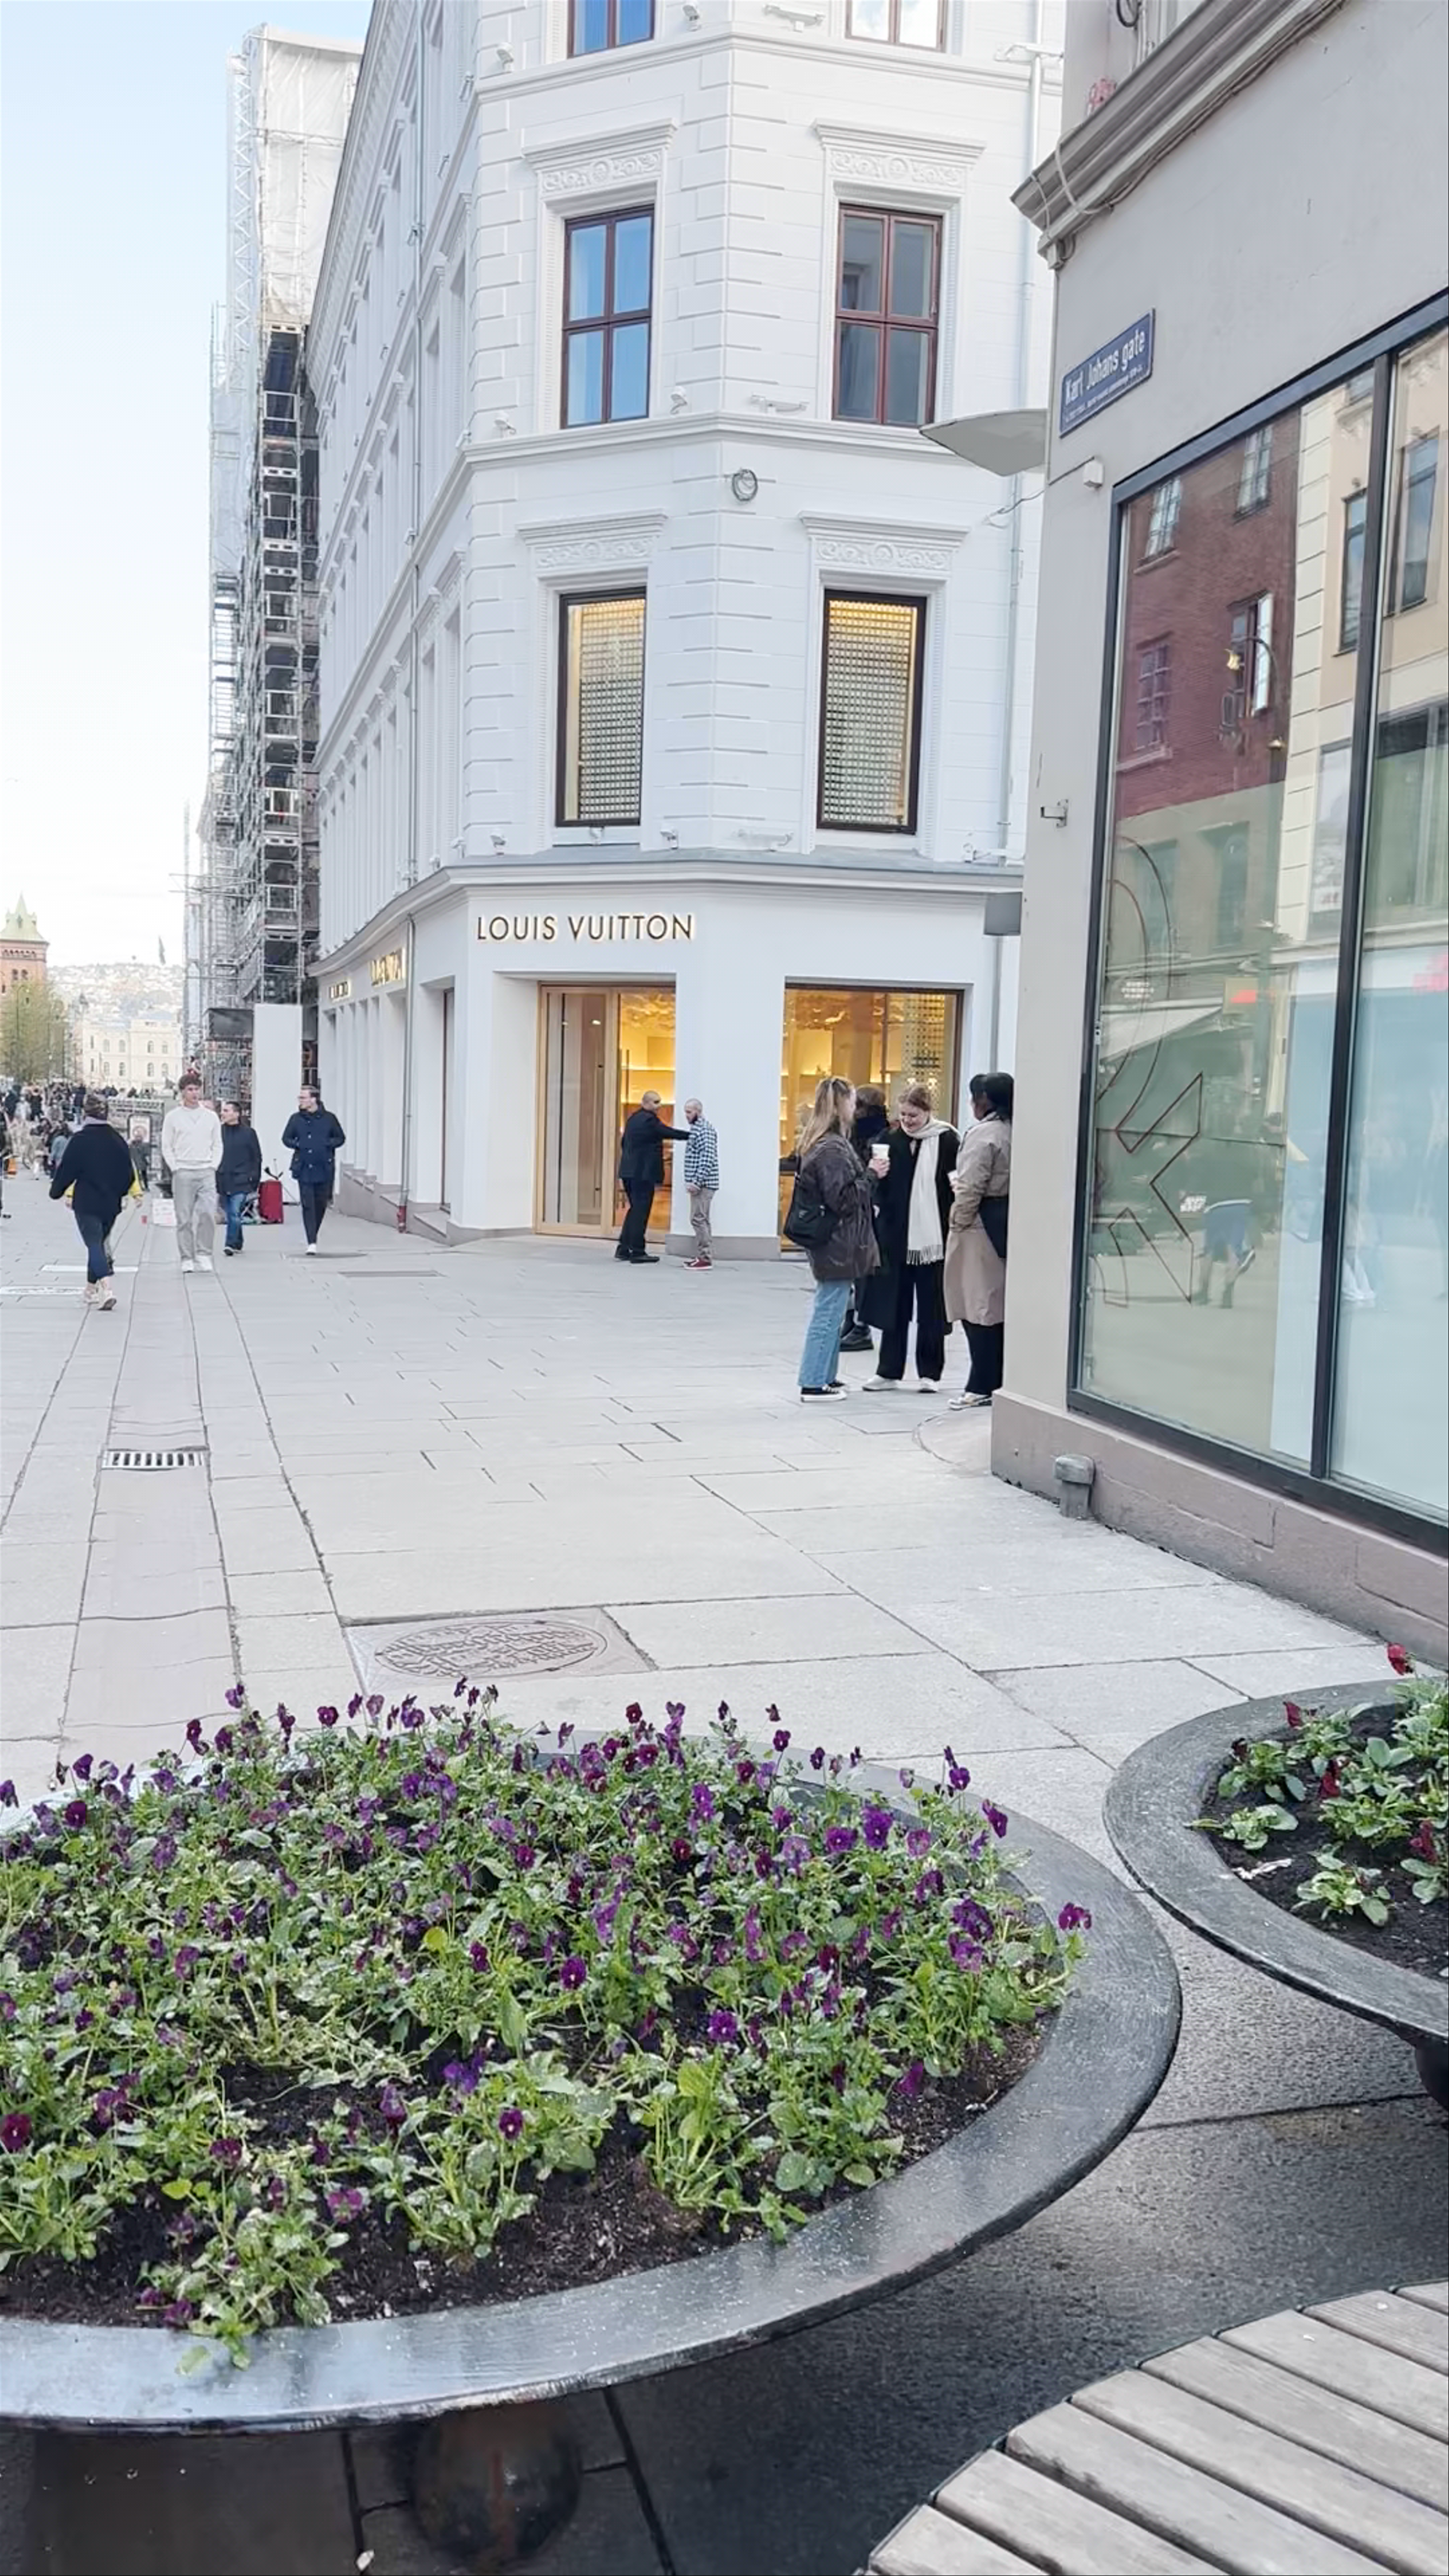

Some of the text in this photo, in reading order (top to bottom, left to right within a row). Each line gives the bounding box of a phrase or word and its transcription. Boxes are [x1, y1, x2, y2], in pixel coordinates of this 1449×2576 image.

[1065, 370, 1083, 406] Karl
[1086, 349, 1119, 390] Johans
[1121, 328, 1145, 371] gate
[477, 914, 692, 940] LOUIS VUITTON
